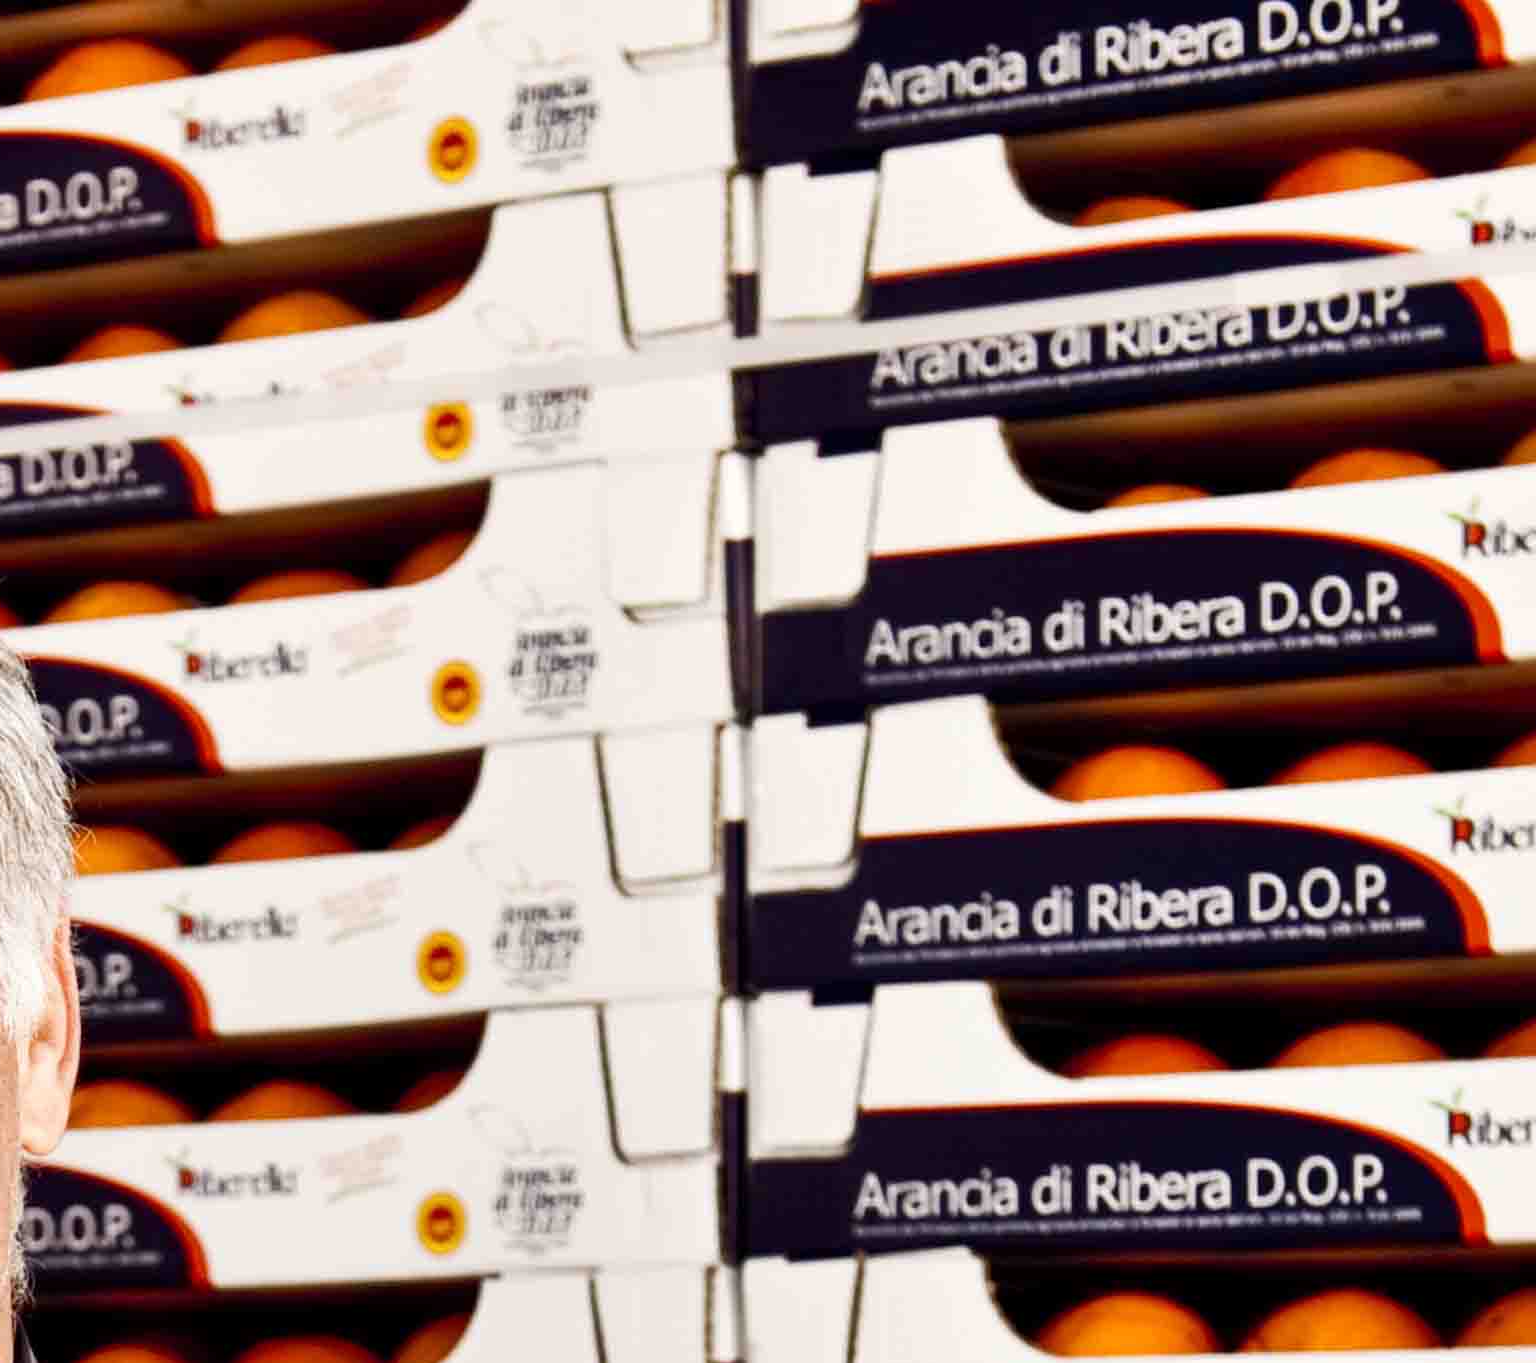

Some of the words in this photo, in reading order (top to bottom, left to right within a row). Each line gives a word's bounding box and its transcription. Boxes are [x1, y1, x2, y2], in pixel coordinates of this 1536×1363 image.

[859, 44, 1027, 110] Arancia
[1039, 31, 1081, 86] di
[1095, 17, 1244, 76] Ribera
[1259, 0, 1403, 53] D.O.P.
[866, 608, 1031, 665] Arancia
[1043, 600, 1084, 652] di
[1099, 592, 1245, 646] Ribera
[1261, 571, 1402, 633] D.O.P.
[854, 1168, 1018, 1219] Arancia
[1032, 1165, 1072, 1215] di
[1087, 1162, 1231, 1212] Ribera
[1248, 1153, 1387, 1209] D.O.P.
